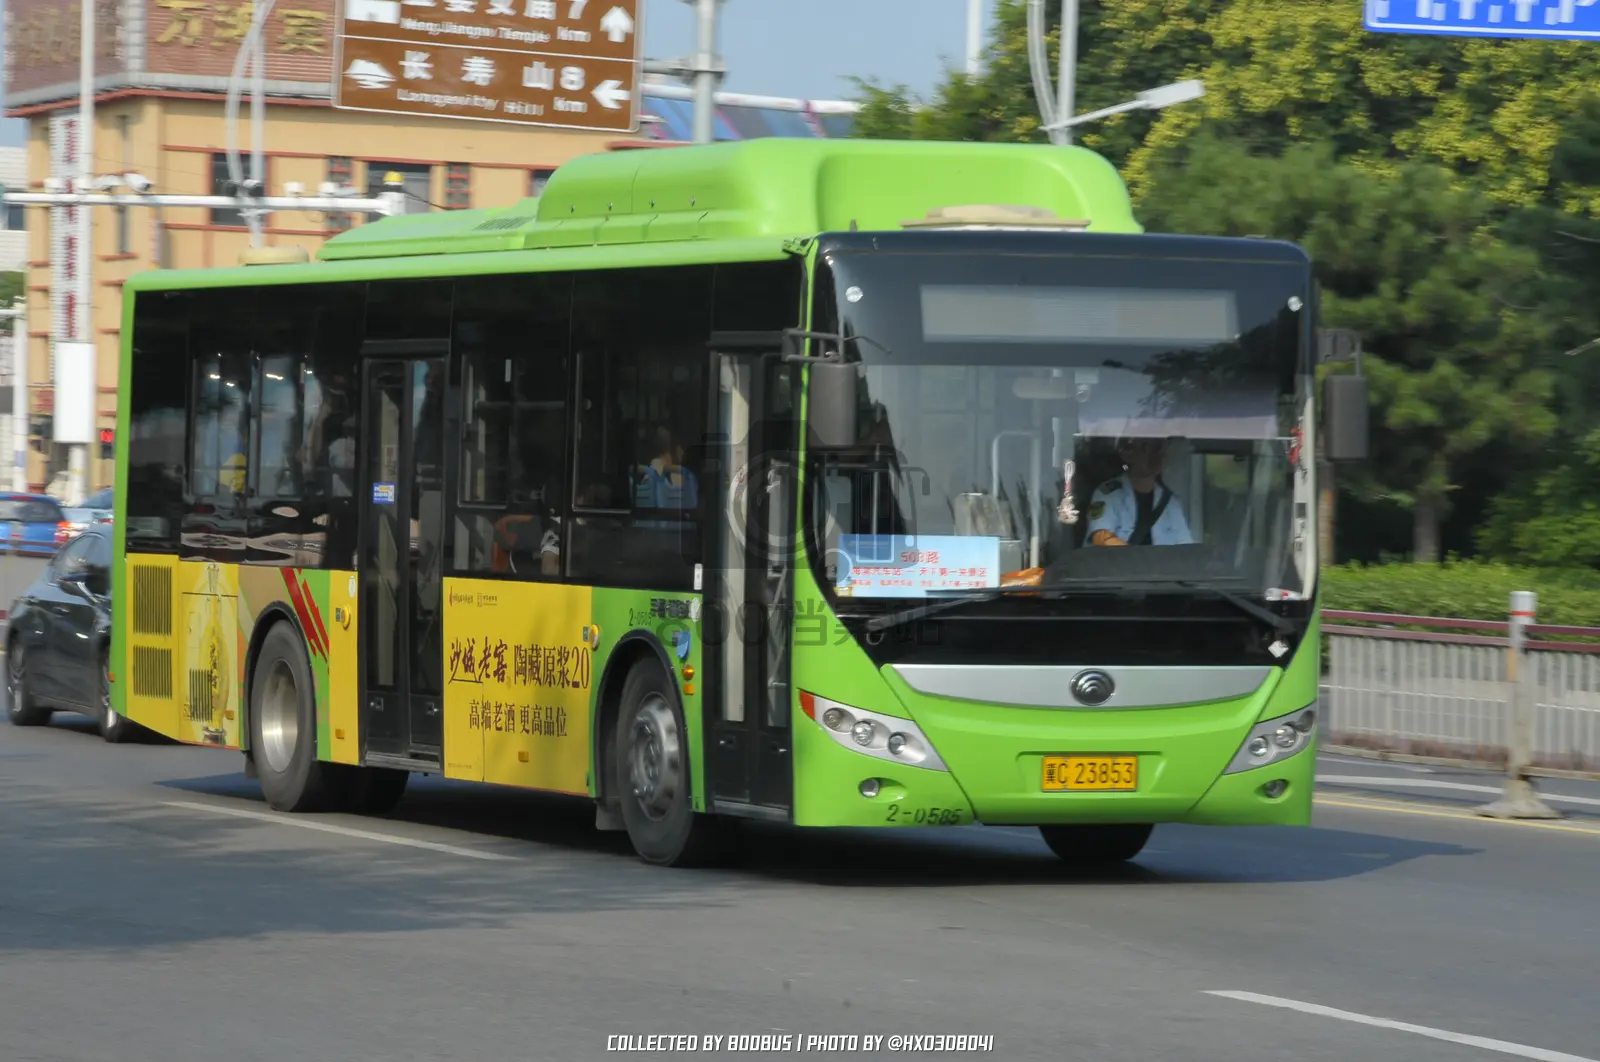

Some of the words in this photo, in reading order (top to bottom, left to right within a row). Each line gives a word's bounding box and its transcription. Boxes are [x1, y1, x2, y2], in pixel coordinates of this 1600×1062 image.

[559, 66, 586, 91] 8
[469, 699, 516, 733] 高端老酒
[520, 704, 568, 737] 更高品位
[1074, 762, 1133, 784] 23853
